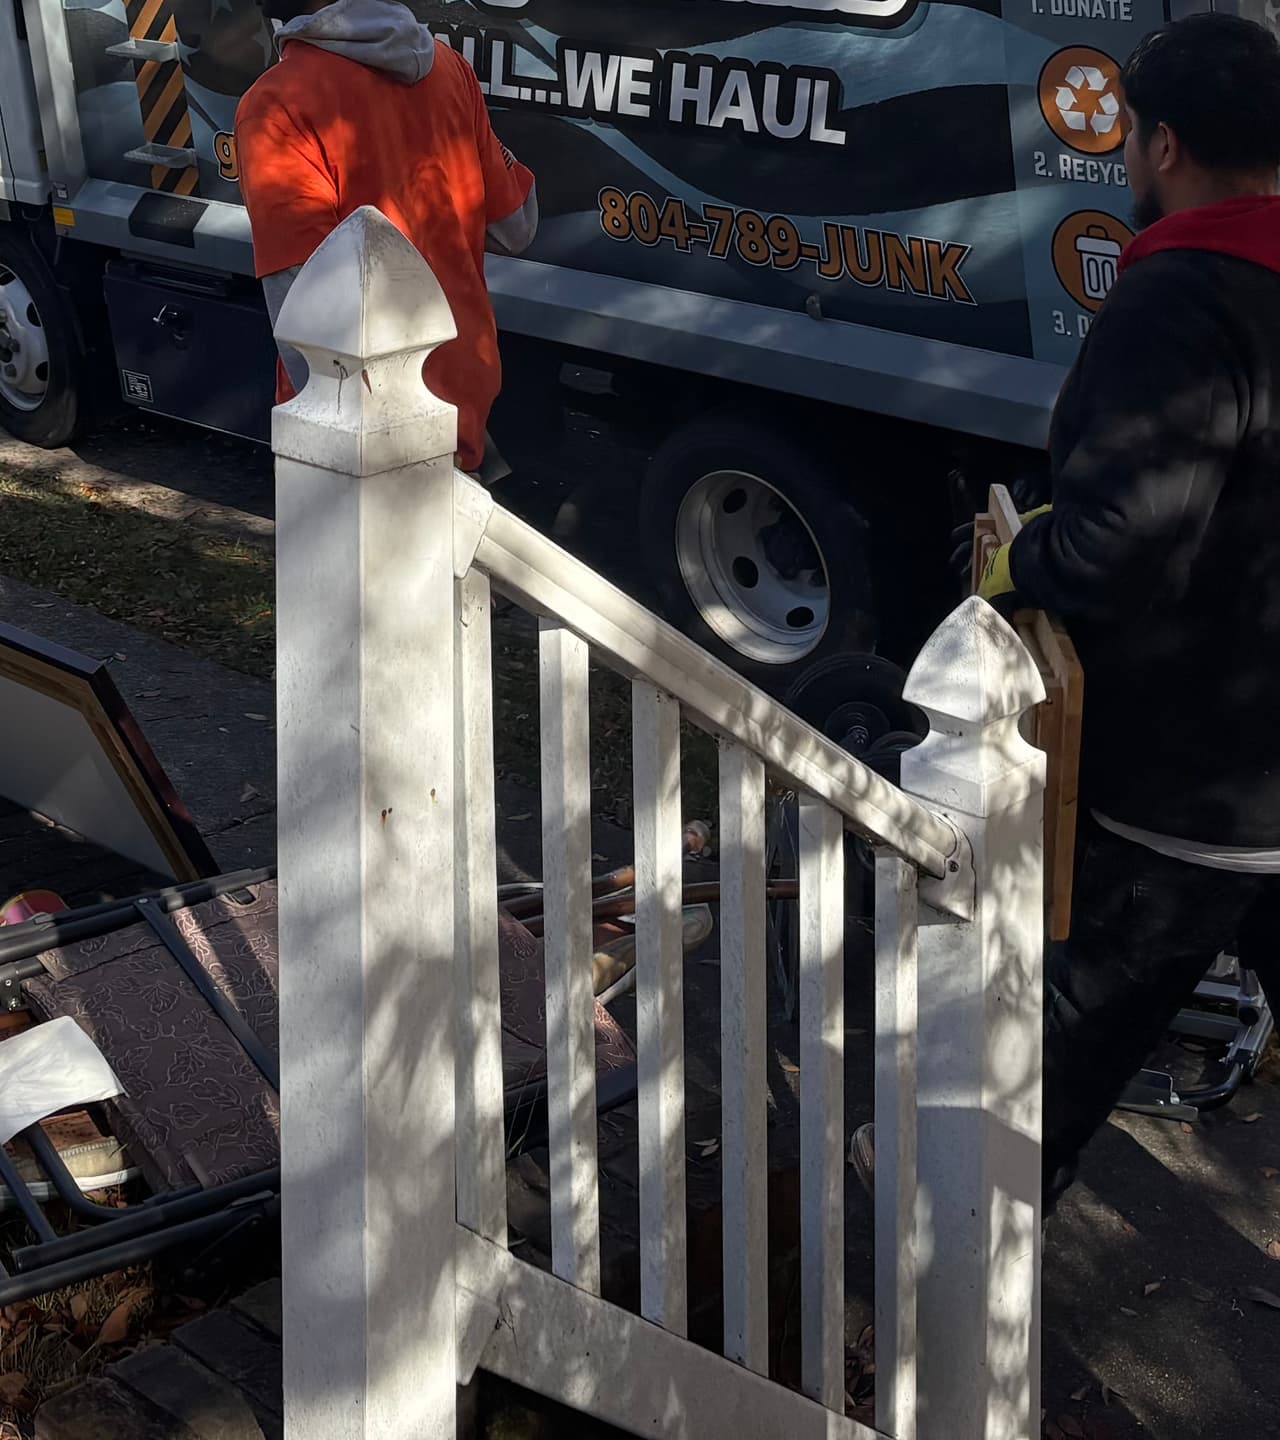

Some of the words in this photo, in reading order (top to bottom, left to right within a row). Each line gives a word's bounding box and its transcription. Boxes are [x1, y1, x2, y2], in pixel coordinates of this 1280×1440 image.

[669, 63, 846, 145] HAUL
[1033, 151, 1052, 177] 2.
[1059, 154, 1129, 186] RECYC
[598, 187, 977, 306] 804-789-JUNK
[1052, 309, 1072, 336] 3.
